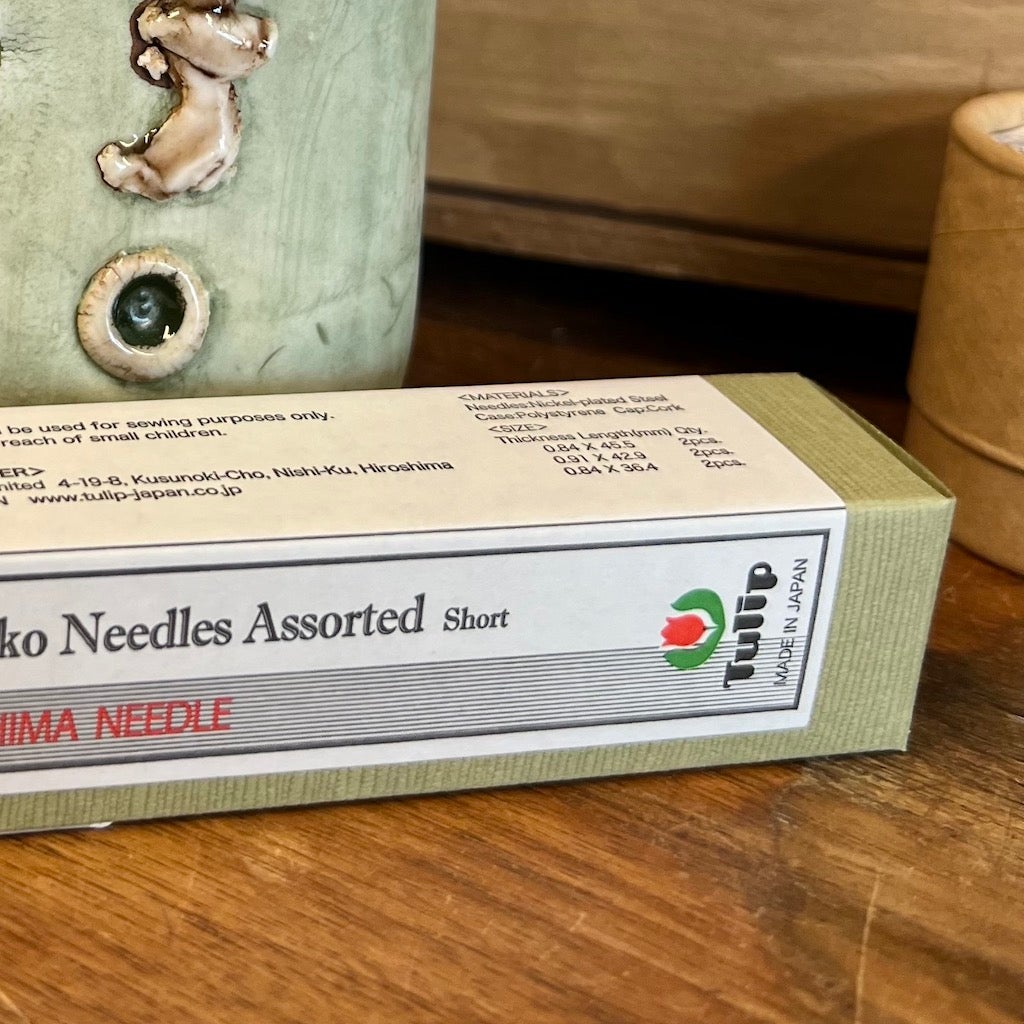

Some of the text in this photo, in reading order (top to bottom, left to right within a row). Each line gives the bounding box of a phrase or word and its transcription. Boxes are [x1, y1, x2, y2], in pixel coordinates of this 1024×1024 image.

[458, 389, 570, 401] <MATERIALS>
[630, 394, 668, 403] Steel
[7, 423, 33, 435] be
[39, 421, 86, 433] used
[90, 420, 120, 431] for
[126, 417, 193, 430] sewing
[197, 411, 286, 426] purposes
[290, 410, 335, 422] only.
[488, 424, 548, 434] <SIZE>
[1, 434, 57, 447] reach
[63, 434, 83, 445] of
[89, 430, 140, 443] small
[145, 427, 228, 440] children.
[494, 426, 708, 445] Thickness Length(mm) Qty.
[543, 444, 580, 453] 0.84
[600, 440, 636, 449] 45.5
[678, 436, 723, 446] 2pcs.
[553, 454, 589, 464] 0.91
[611, 451, 647, 461] 42.9
[689, 447, 734, 458] 2pcs.
[621, 462, 659, 472] 36.4
[701, 458, 747, 469] 2pcs.
[58, 476, 128, 488] 4-19-8,
[131, 468, 271, 485] Kusunoki-Cho,
[273, 463, 358, 478] Nishi-Ku,
[359, 459, 454, 474] Hiroshima
[28, 484, 242, 504] www.tulip-japan.co.jp
[59, 606, 233, 655] Needles
[242, 592, 426, 644] Assorted
[443, 607, 510, 631] Short
[723, 561, 778, 688] Tulip
[773, 558, 808, 686] MADE IN JAPAN
[95, 697, 234, 740] NEEDLE
